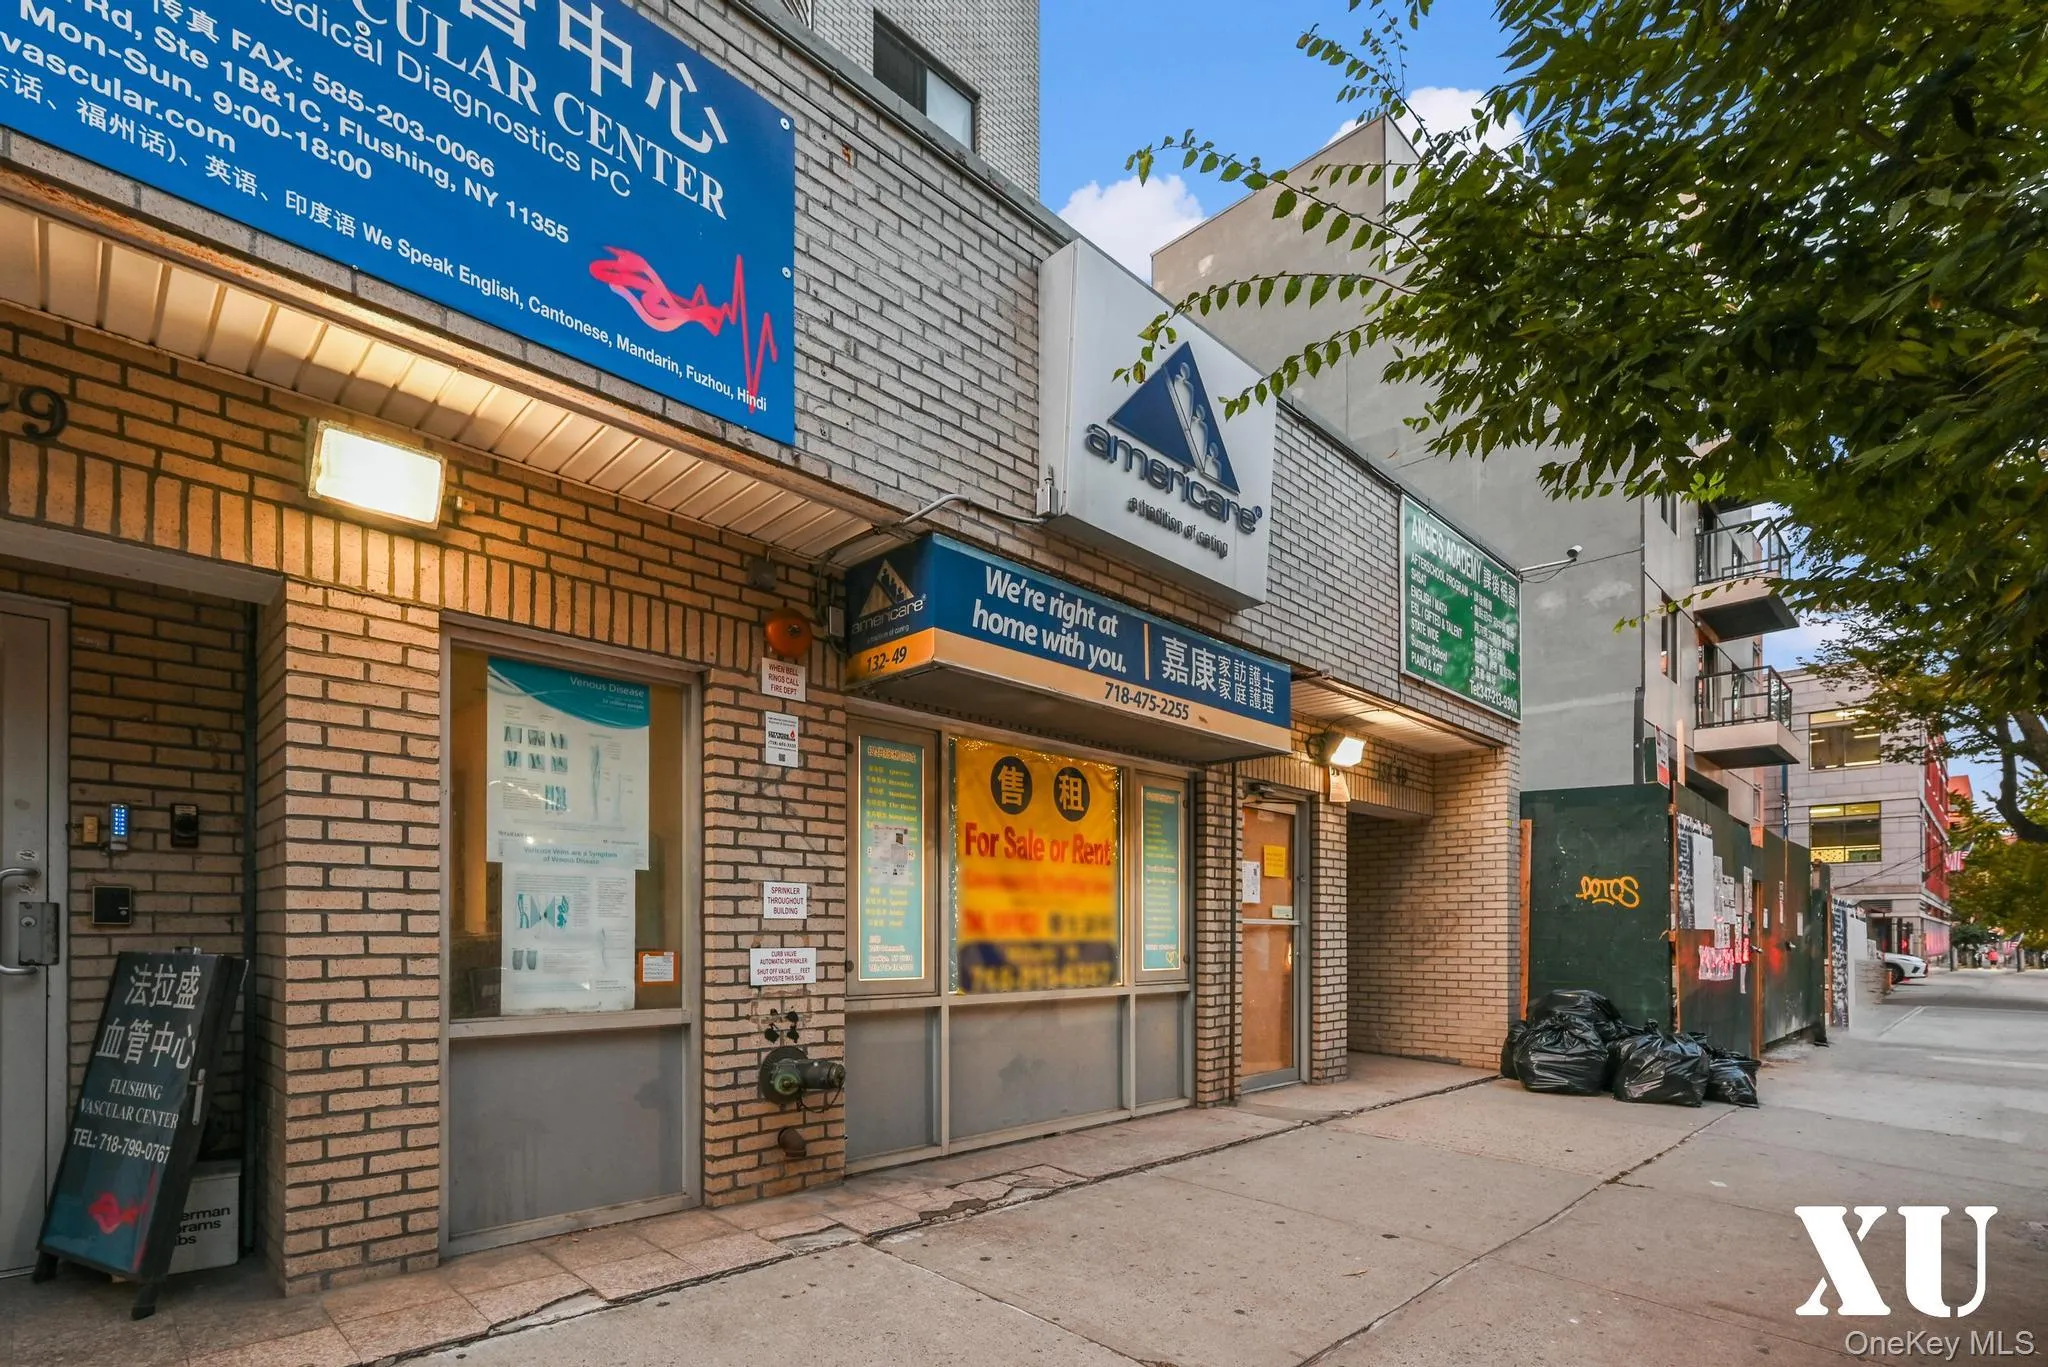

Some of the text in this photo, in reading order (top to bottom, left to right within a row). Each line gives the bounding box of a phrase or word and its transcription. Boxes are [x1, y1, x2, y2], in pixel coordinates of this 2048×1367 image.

[20, 0, 372, 180] Mon-Sun. 9:00-18:00
[232, 28, 303, 83] FAX:
[312, 71, 497, 177] 585-203-0066
[260, 0, 631, 197] edical Diagnostics PC
[154, 26, 209, 69] Ste
[220, 60, 330, 132] 1B&1C,
[339, 115, 456, 192] Flushing,
[464, 176, 499, 208] NY
[506, 200, 569, 243] 11355
[554, 92, 727, 220] CENTER
[362, 222, 393, 250] We
[398, 238, 454, 278] Speak
[459, 264, 524, 310] English,
[528, 296, 613, 348] Cantonese,
[617, 333, 684, 379] Mandarin,
[686, 365, 735, 400] Fuzhou,
[737, 387, 767, 412] Hindi
[1138, 498, 1183, 534] tradition
[1184, 524, 1197, 540] of
[1196, 531, 1229, 559] caring
[1411, 514, 1444, 559] ANGIE'S
[1446, 538, 1482, 585] ACADEMY
[1411, 552, 1469, 597] AFTERSCHOOL PROGRAM
[986, 565, 1119, 638] We're right at
[1411, 584, 1432, 606] ENGLISH
[1435, 599, 1448, 617] MATH
[1411, 600, 1421, 617] ESL
[1424, 608, 1441, 628] GIFTED
[1446, 619, 1463, 640] TALENT
[972, 599, 1127, 674] home with you.
[1411, 617, 1440, 643] STATE WIDE
[1411, 634, 1448, 663] Summer School
[768, 663, 799, 677] WHEN BELL
[768, 673, 799, 687] RINGS CALL
[1161, 635, 1217, 693] 嘉康
[1411, 651, 1428, 670] PIANO
[1433, 661, 1443, 677] ART
[570, 676, 645, 698] Venous Disease
[770, 684, 797, 695] FIRE DEPT
[1104, 681, 1190, 721] 718-475-2255
[997, 764, 1084, 812] 售 租
[965, 821, 999, 858] For
[1004, 825, 1045, 862] Sale
[1050, 840, 1068, 865] or
[1072, 833, 1112, 866] Rent
[767, 896, 804, 905] THROUGHOUT
[771, 886, 801, 895] SPRINKLER
[773, 906, 798, 915] BUILDING
[124, 963, 202, 1010] 法拉盛
[96, 1017, 197, 1070] 血管中心
[108, 1078, 164, 1101] FLUSHING
[80, 1097, 180, 1130] VASCULAR CENTER
[73, 1128, 98, 1149] TEL:
